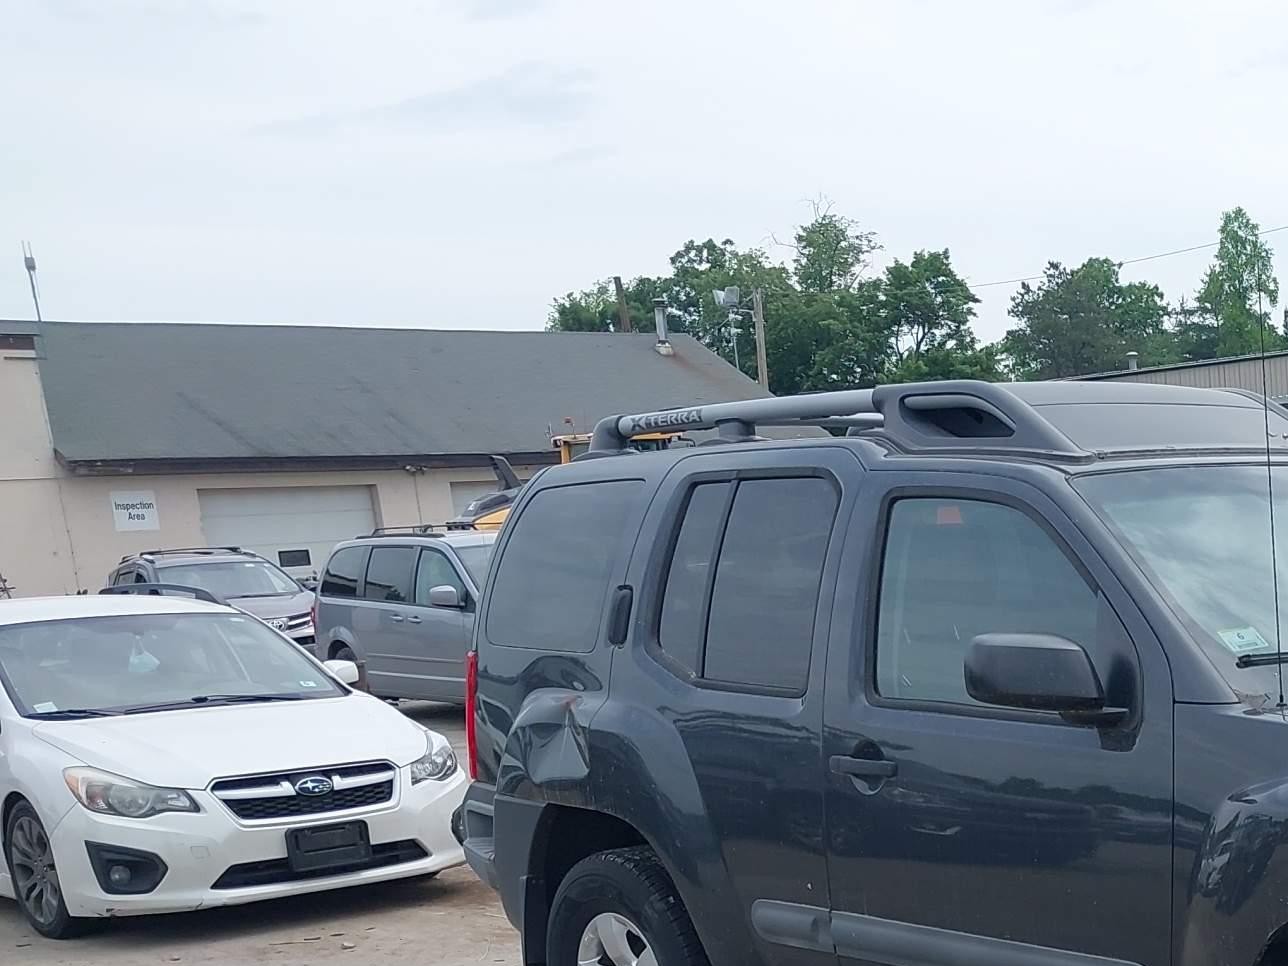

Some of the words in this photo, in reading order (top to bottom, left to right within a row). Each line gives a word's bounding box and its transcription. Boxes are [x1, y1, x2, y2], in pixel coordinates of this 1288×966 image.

[631, 411, 700, 430] XTERRA
[114, 501, 154, 511] Inspection
[128, 512, 145, 520] Area
